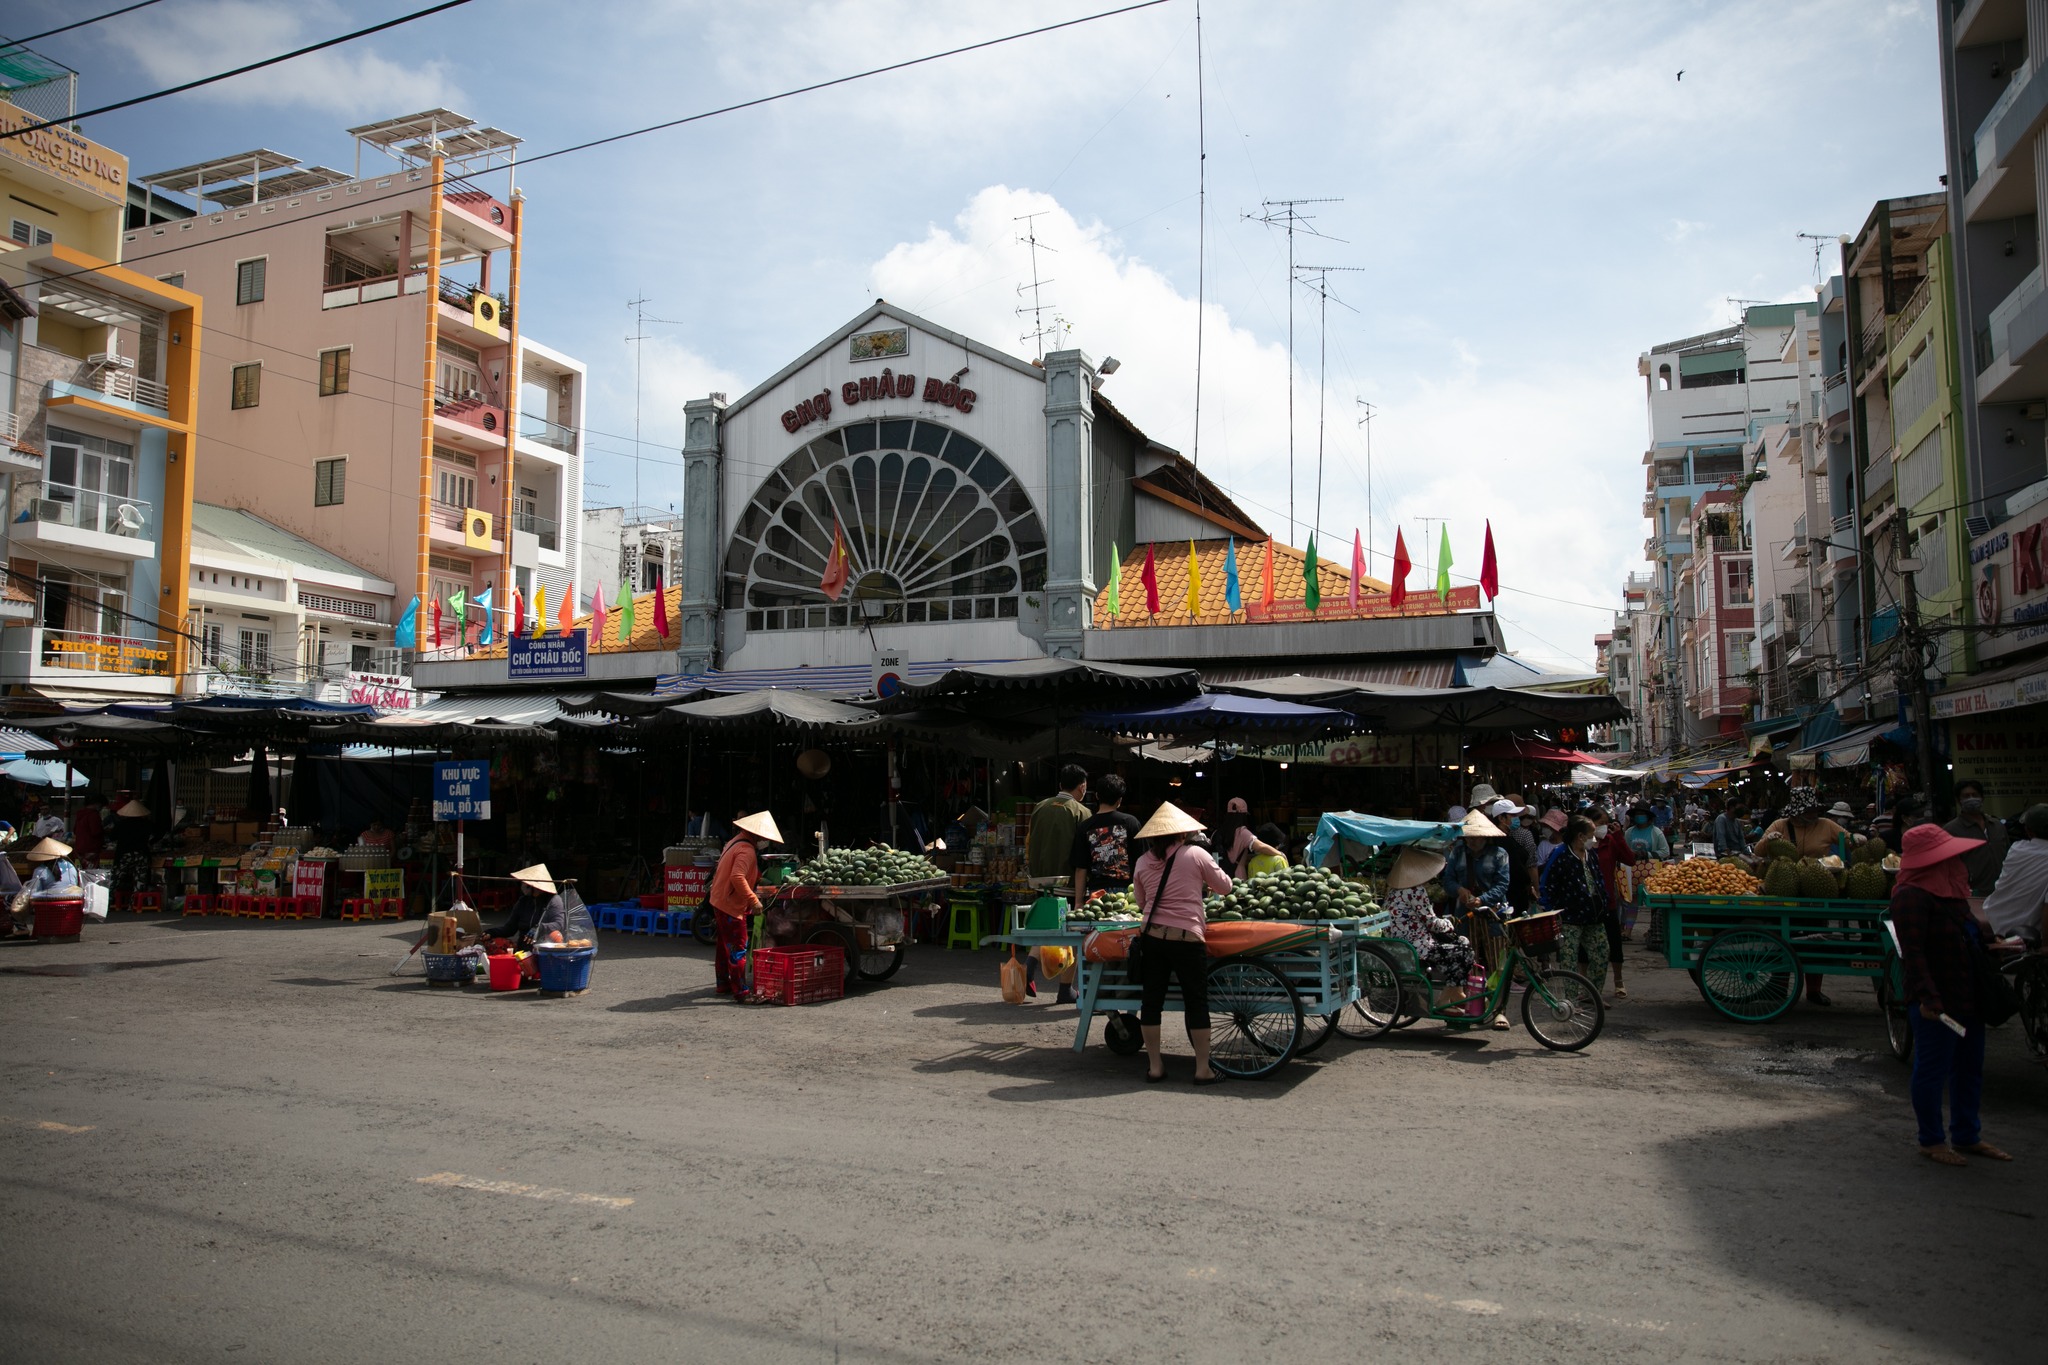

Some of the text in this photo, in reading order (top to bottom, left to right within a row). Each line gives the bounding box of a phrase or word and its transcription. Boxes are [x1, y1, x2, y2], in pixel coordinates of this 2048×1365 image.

[780, 366, 977, 434] CHỢ CHÂU ĐỐC
[528, 640, 566, 651] CÔNG NHẬN
[512, 646, 581, 669] CHỢ CHÂU ĐỐC
[881, 657, 899, 667] ZONE
[1955, 696, 1973, 714] KIM
[1974, 688, 1989, 712] HÀ
[1957, 733, 2009, 751] KIM
[1331, 741, 1361, 766] CÔ
[1368, 741, 1402, 765] TƯ
[442, 766, 481, 783] KHU VỰC
[449, 780, 471, 796] CẤM
[668, 868, 683, 880] THỐT
[684, 868, 696, 880] NỐT
[668, 882, 684, 892] NƯỚC
[685, 880, 700, 893] THỐT
[668, 894, 694, 905] NGUYÊN
